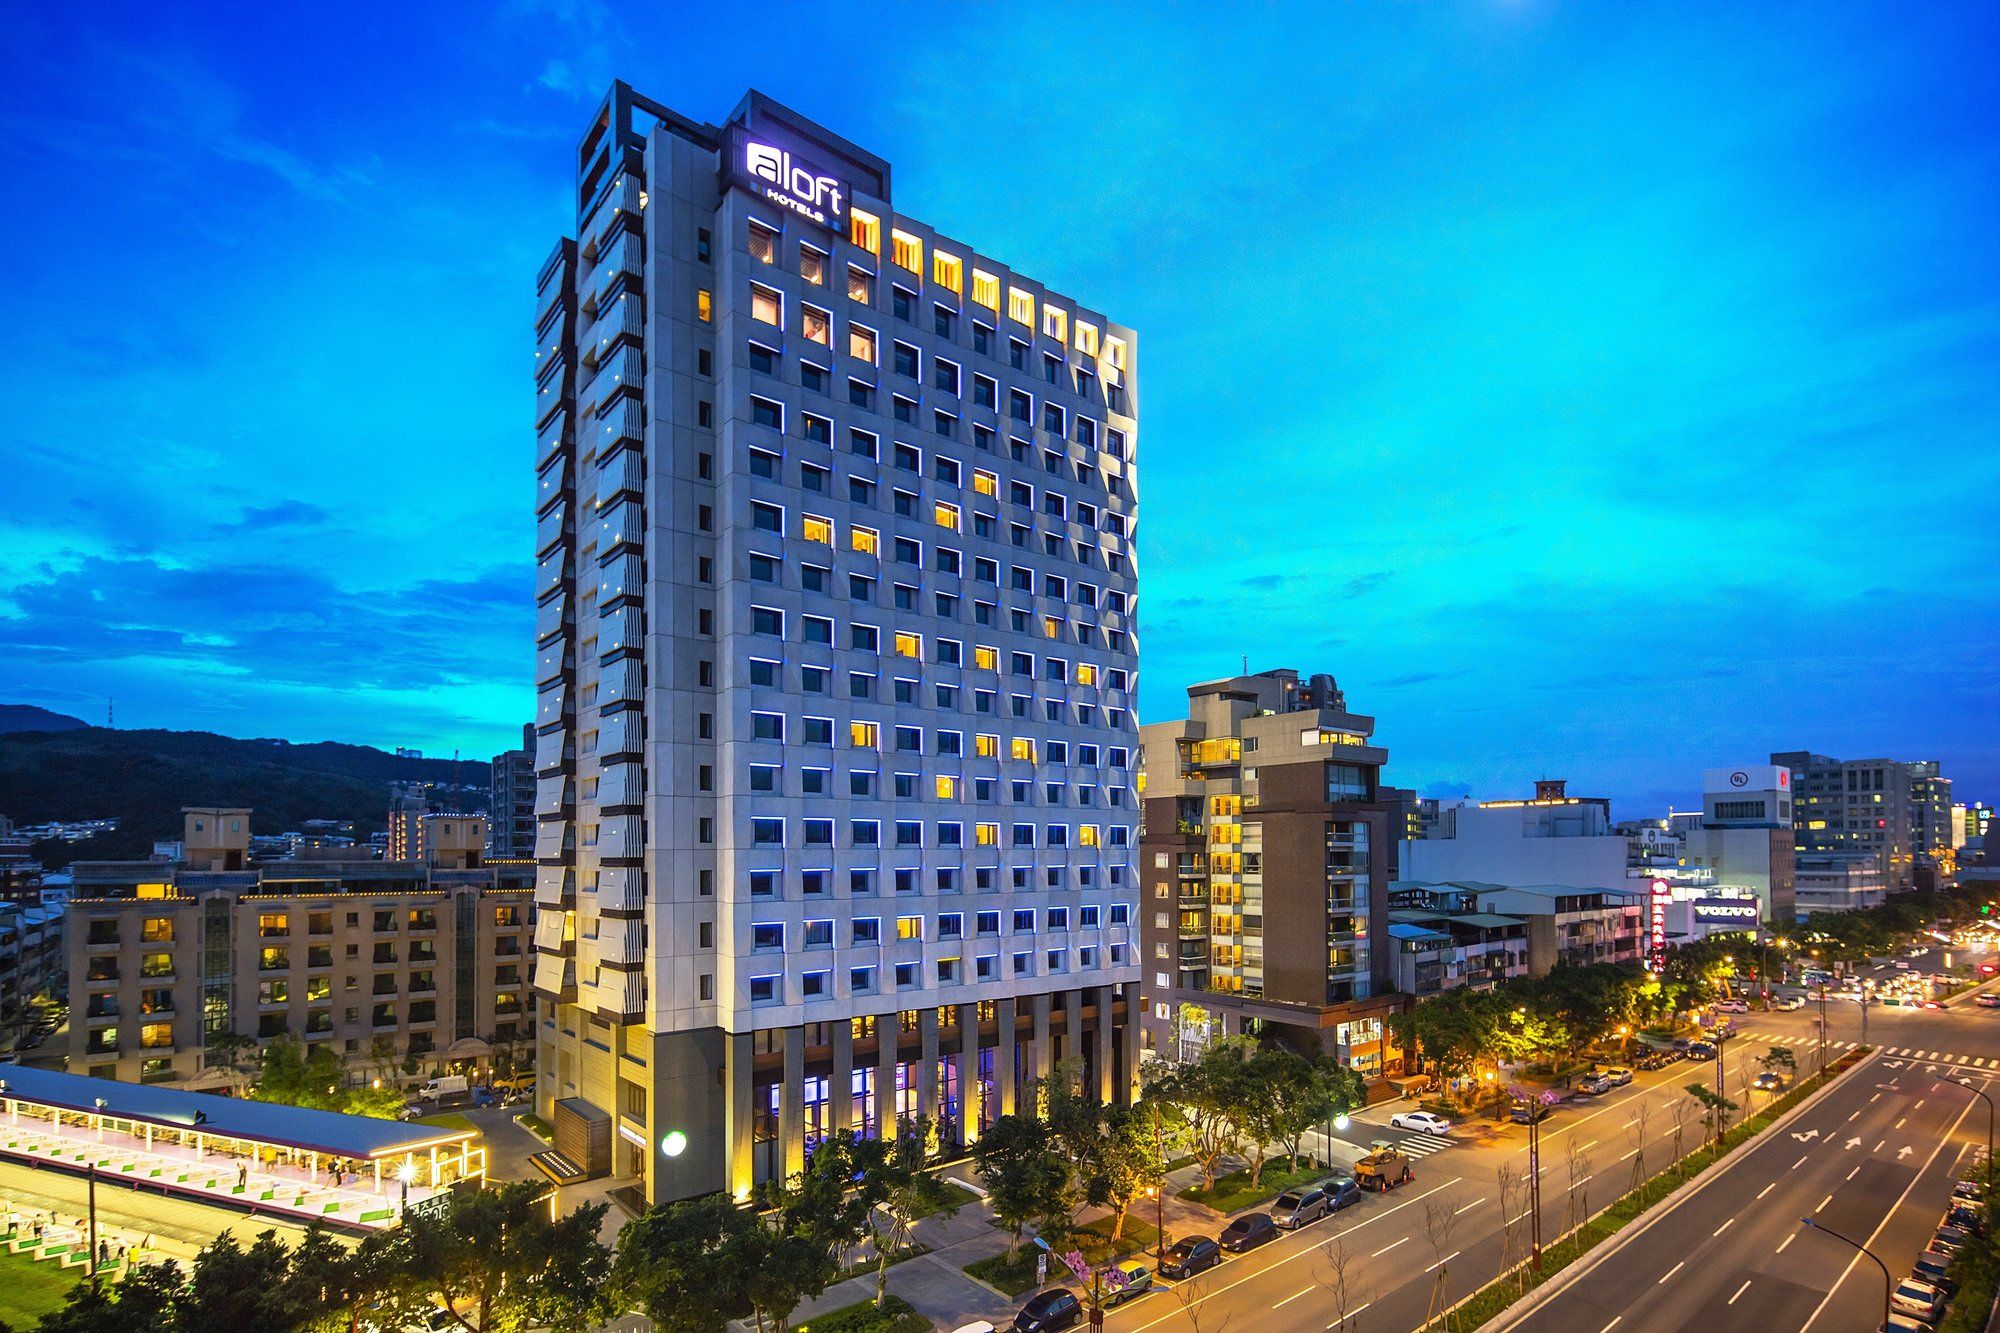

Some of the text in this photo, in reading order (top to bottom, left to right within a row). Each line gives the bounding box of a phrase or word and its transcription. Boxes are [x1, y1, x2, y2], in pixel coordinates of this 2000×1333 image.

[747, 142, 842, 215] aloft
[767, 189, 824, 222] HOTELS
[1694, 906, 1757, 917] VOLVO
